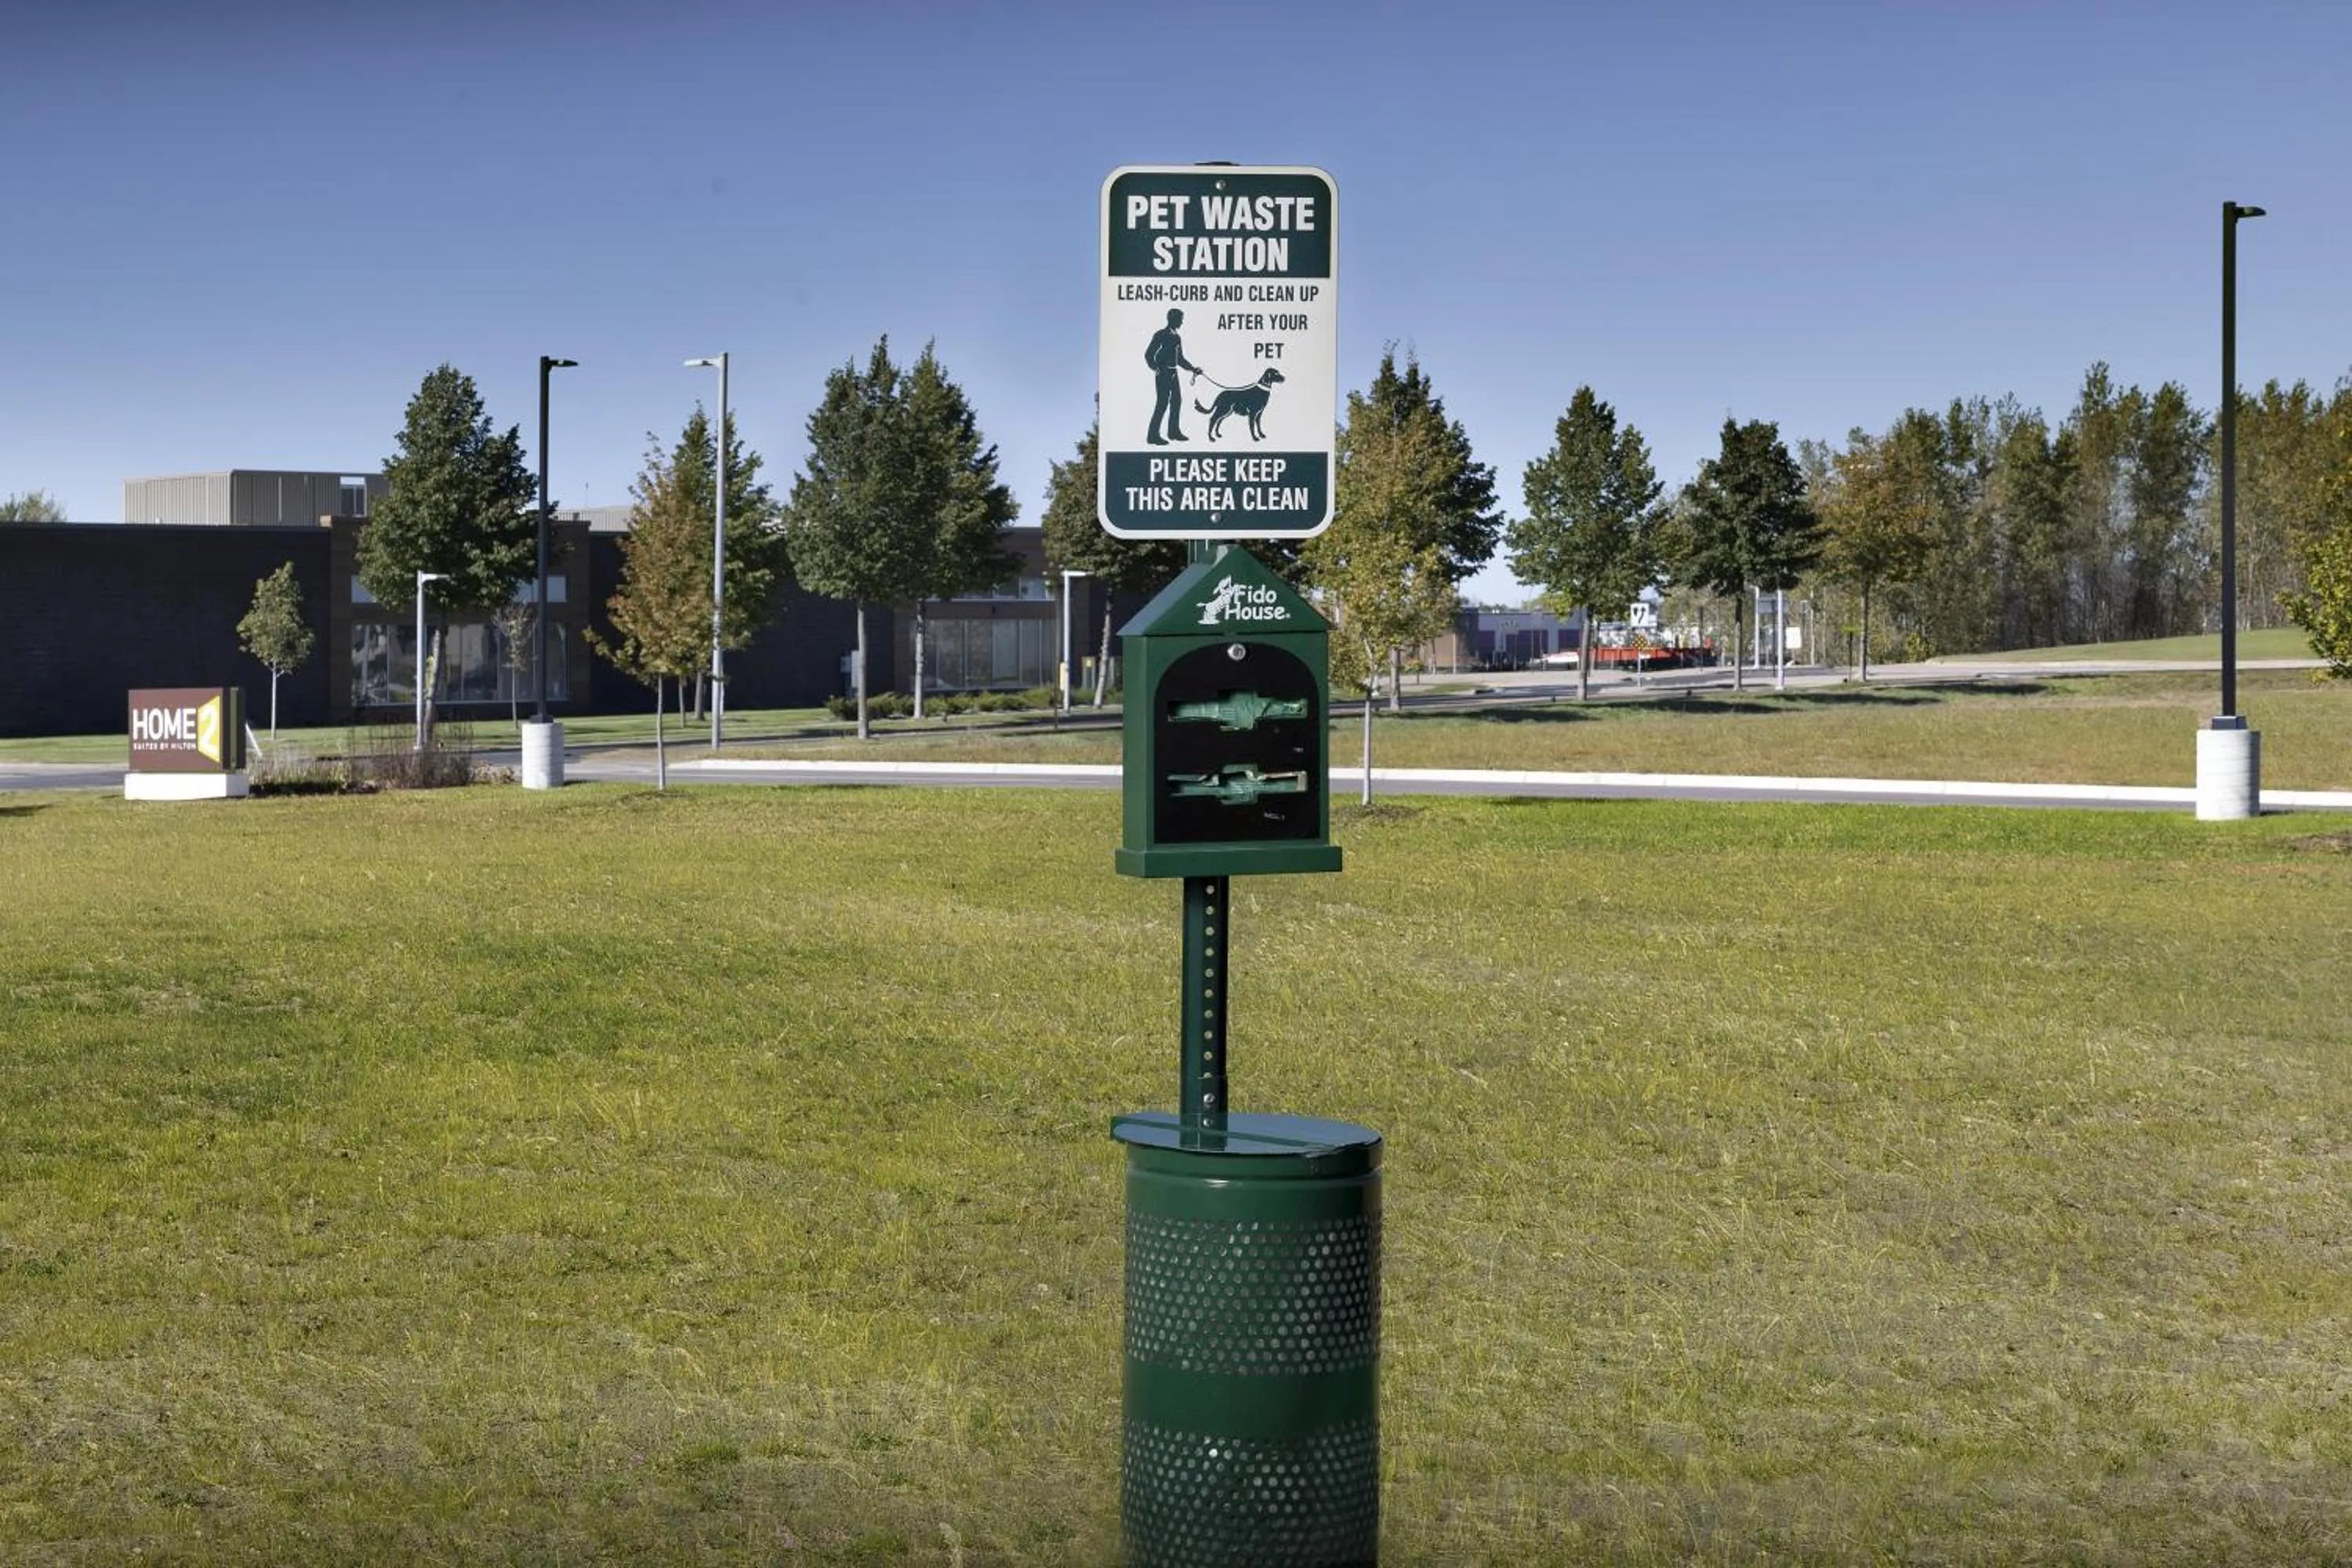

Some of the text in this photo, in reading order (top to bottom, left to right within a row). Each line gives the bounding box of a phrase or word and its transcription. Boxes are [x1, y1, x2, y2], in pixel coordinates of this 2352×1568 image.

[1127, 195, 1315, 231] PET WASTE
[1153, 236, 1288, 271] STATION
[1117, 285, 1319, 302] LEASH-CURB AND CLEAN UP
[1217, 314, 1308, 330] AFTER YOUR
[1254, 343, 1284, 359] PET
[1149, 459, 1287, 482] PLEASE KEEP
[1125, 487, 1308, 511] THIS AREA CLEAN
[1233, 583, 1277, 604] Fido
[132, 708, 196, 740] HOME
